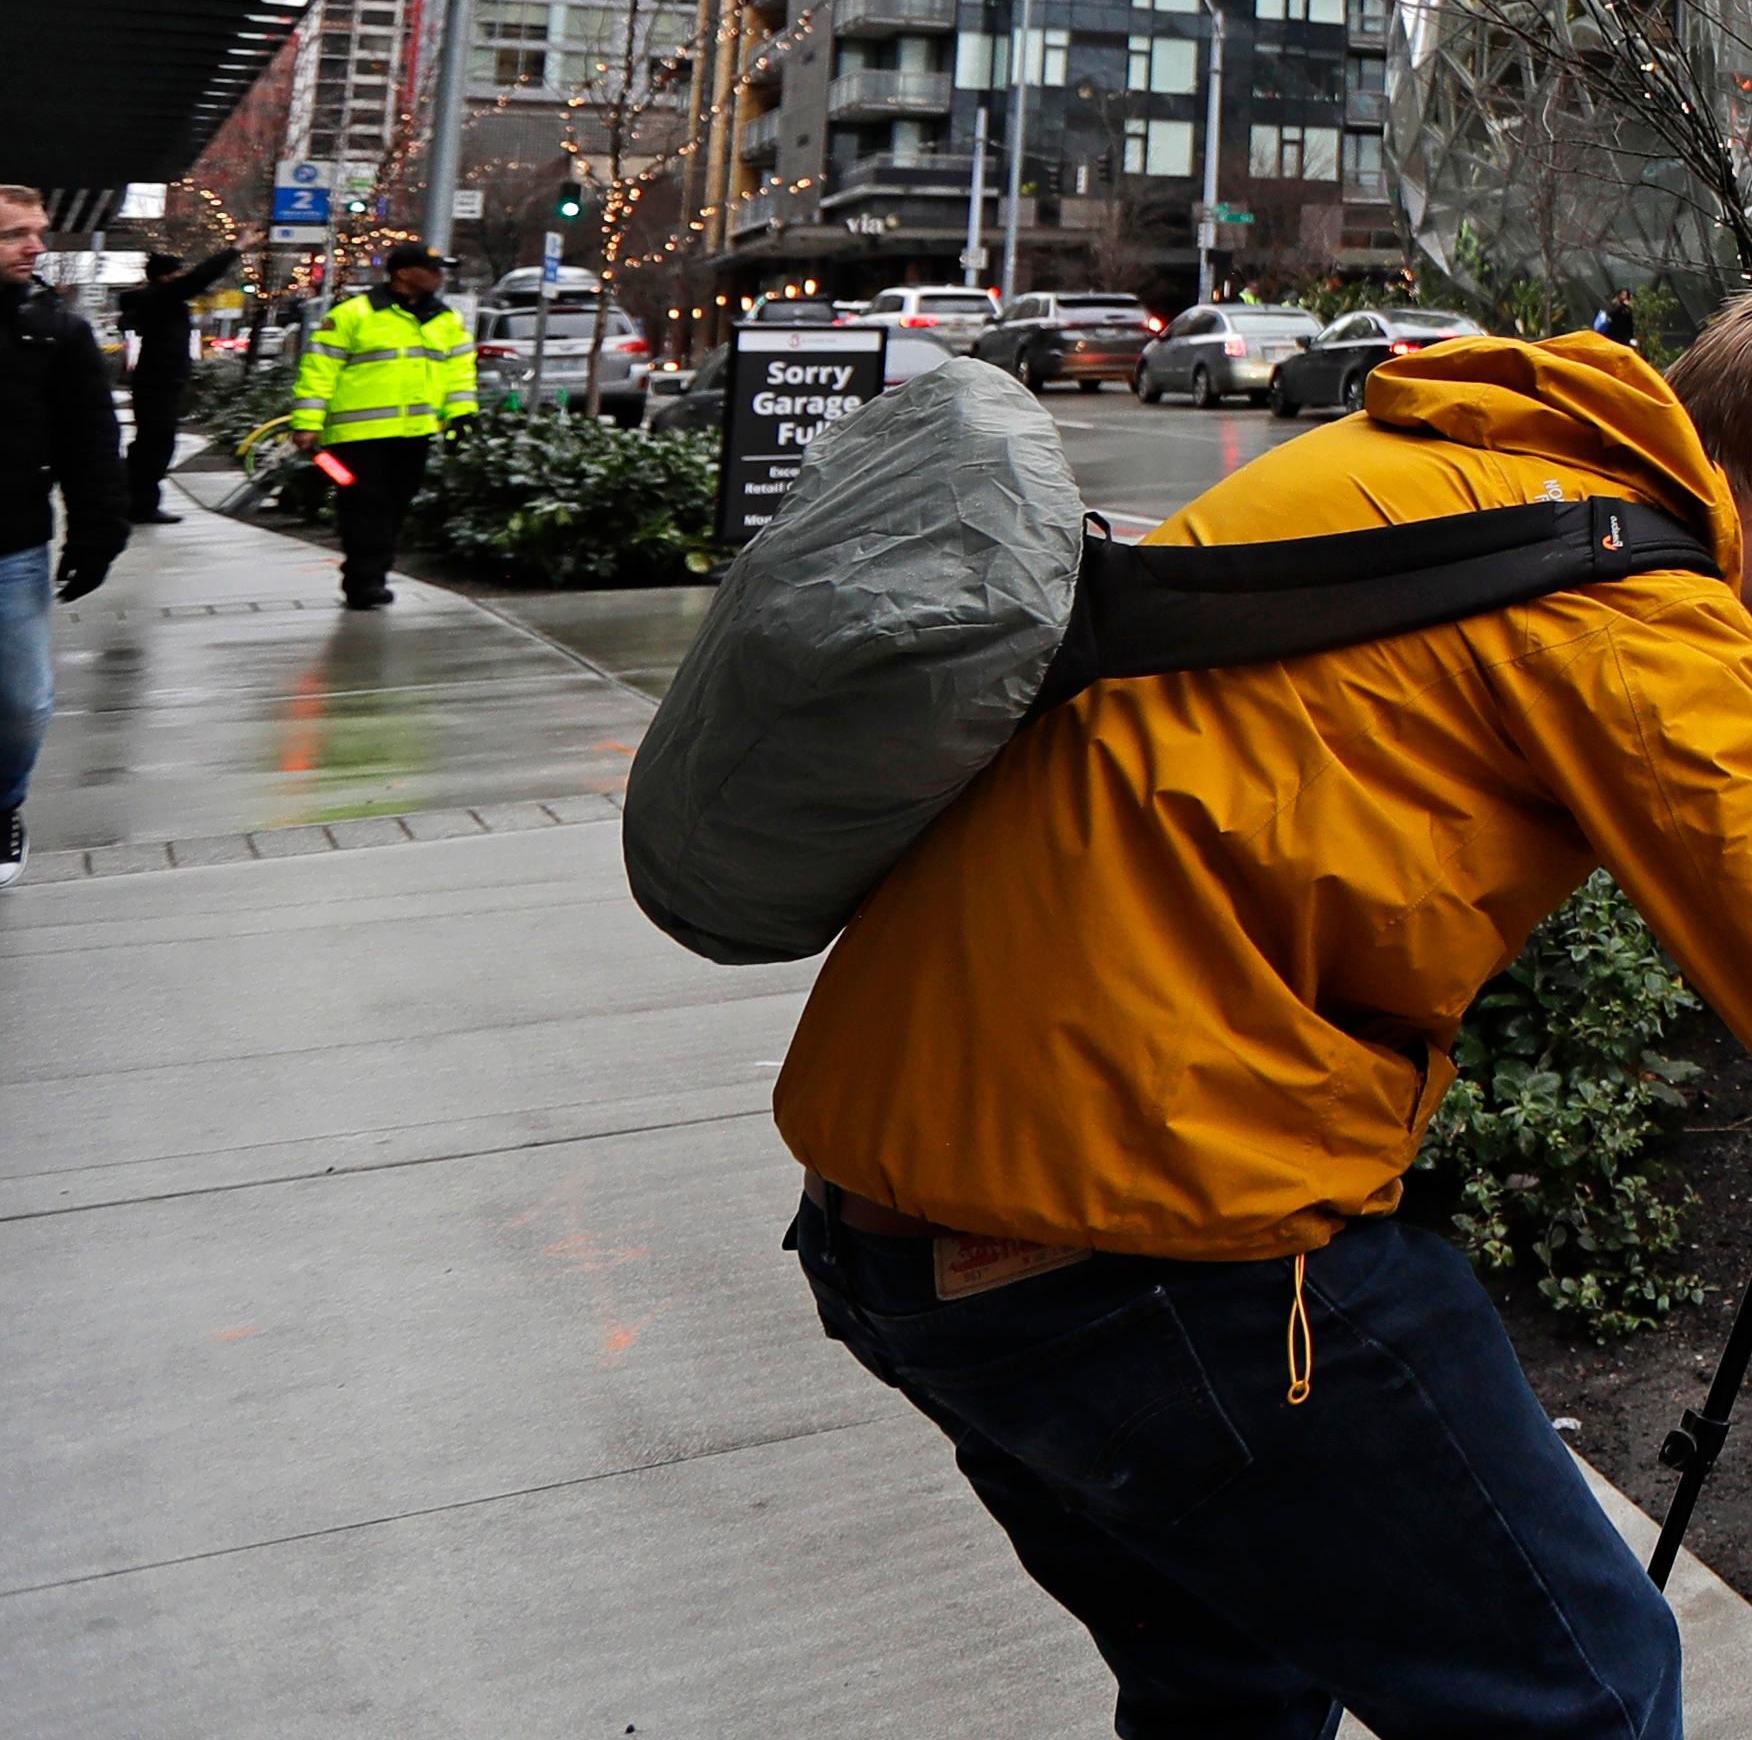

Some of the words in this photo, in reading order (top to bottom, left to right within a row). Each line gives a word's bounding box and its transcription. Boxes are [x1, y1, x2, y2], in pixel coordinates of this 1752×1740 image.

[291, 191, 314, 210] 2
[767, 361, 853, 390] Sorry
[753, 392, 861, 419] Garage
[744, 482, 784, 495] Retail
